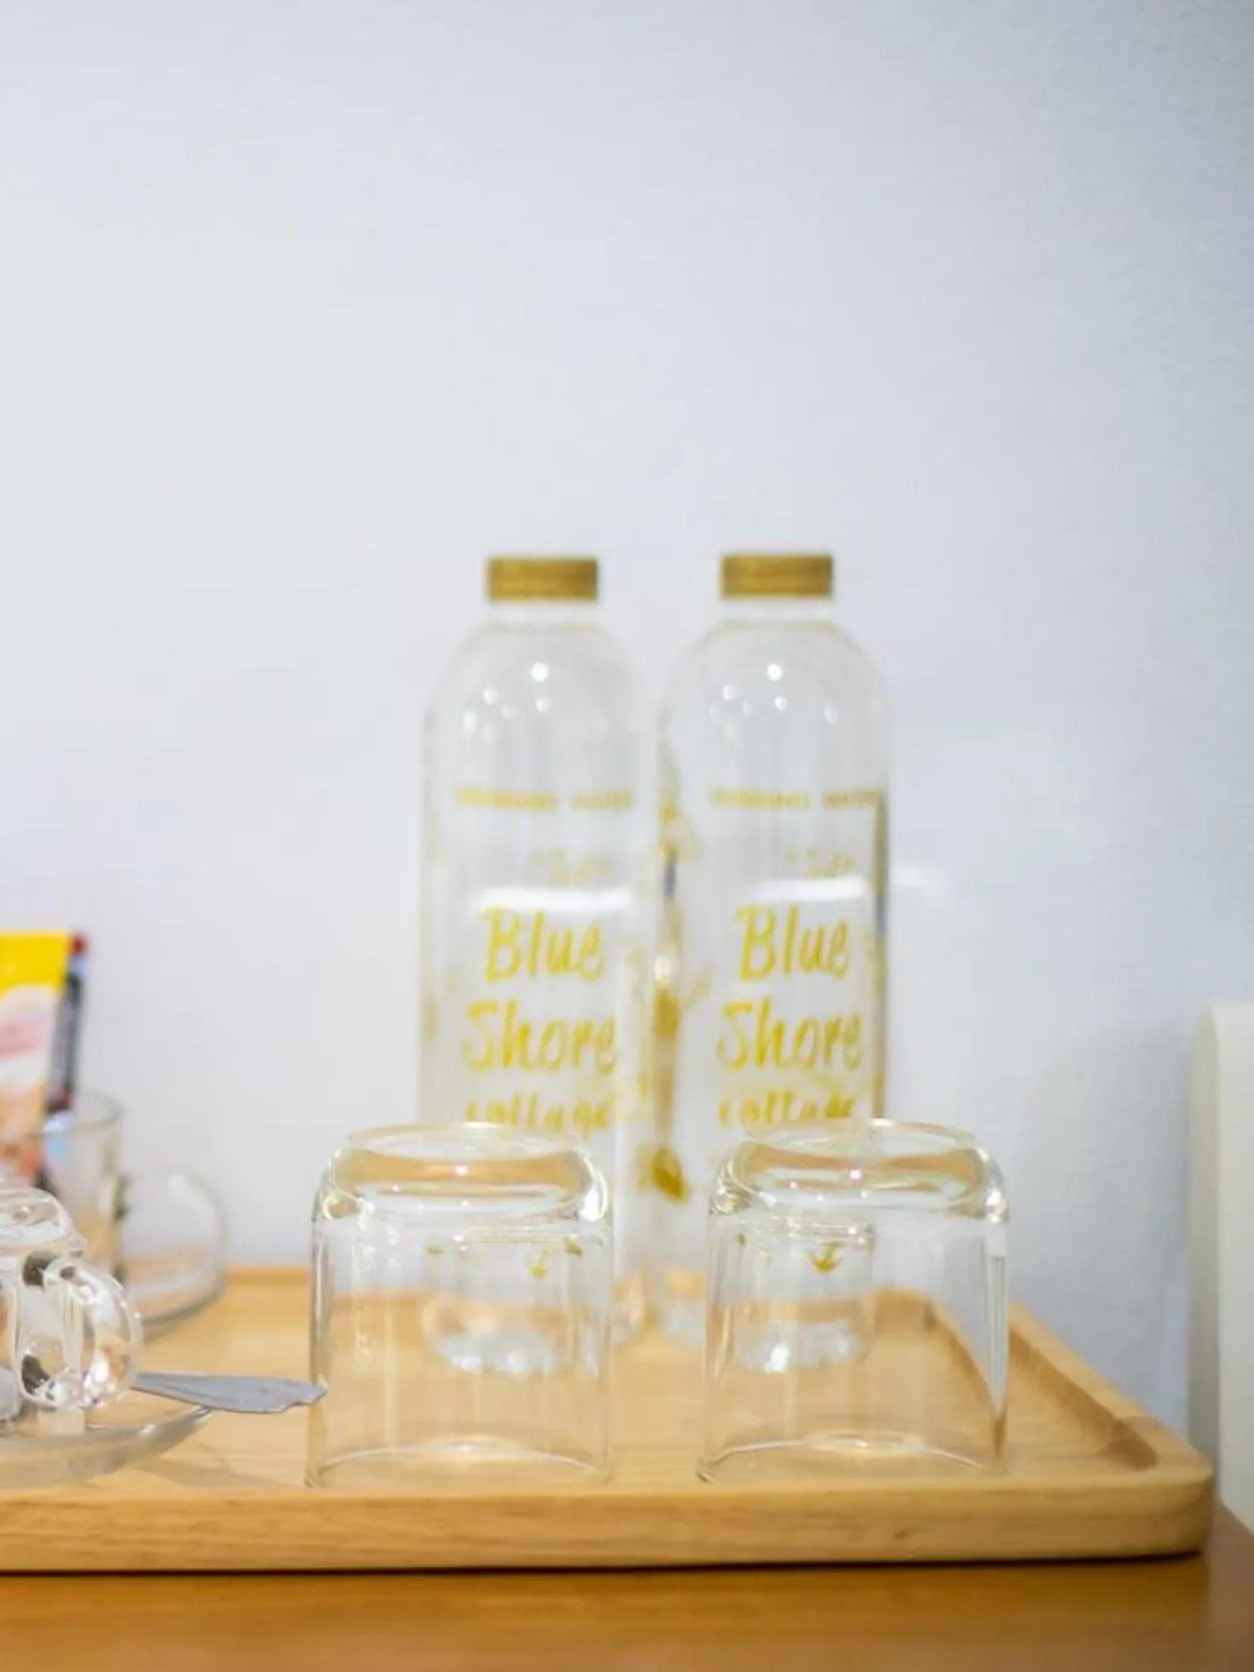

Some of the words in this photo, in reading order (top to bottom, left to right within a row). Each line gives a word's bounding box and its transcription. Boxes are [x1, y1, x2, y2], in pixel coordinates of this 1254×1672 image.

[482, 905, 605, 982] Blue
[735, 903, 851, 980] Blue
[460, 999, 617, 1075] Shore
[717, 995, 862, 1071] Shore
